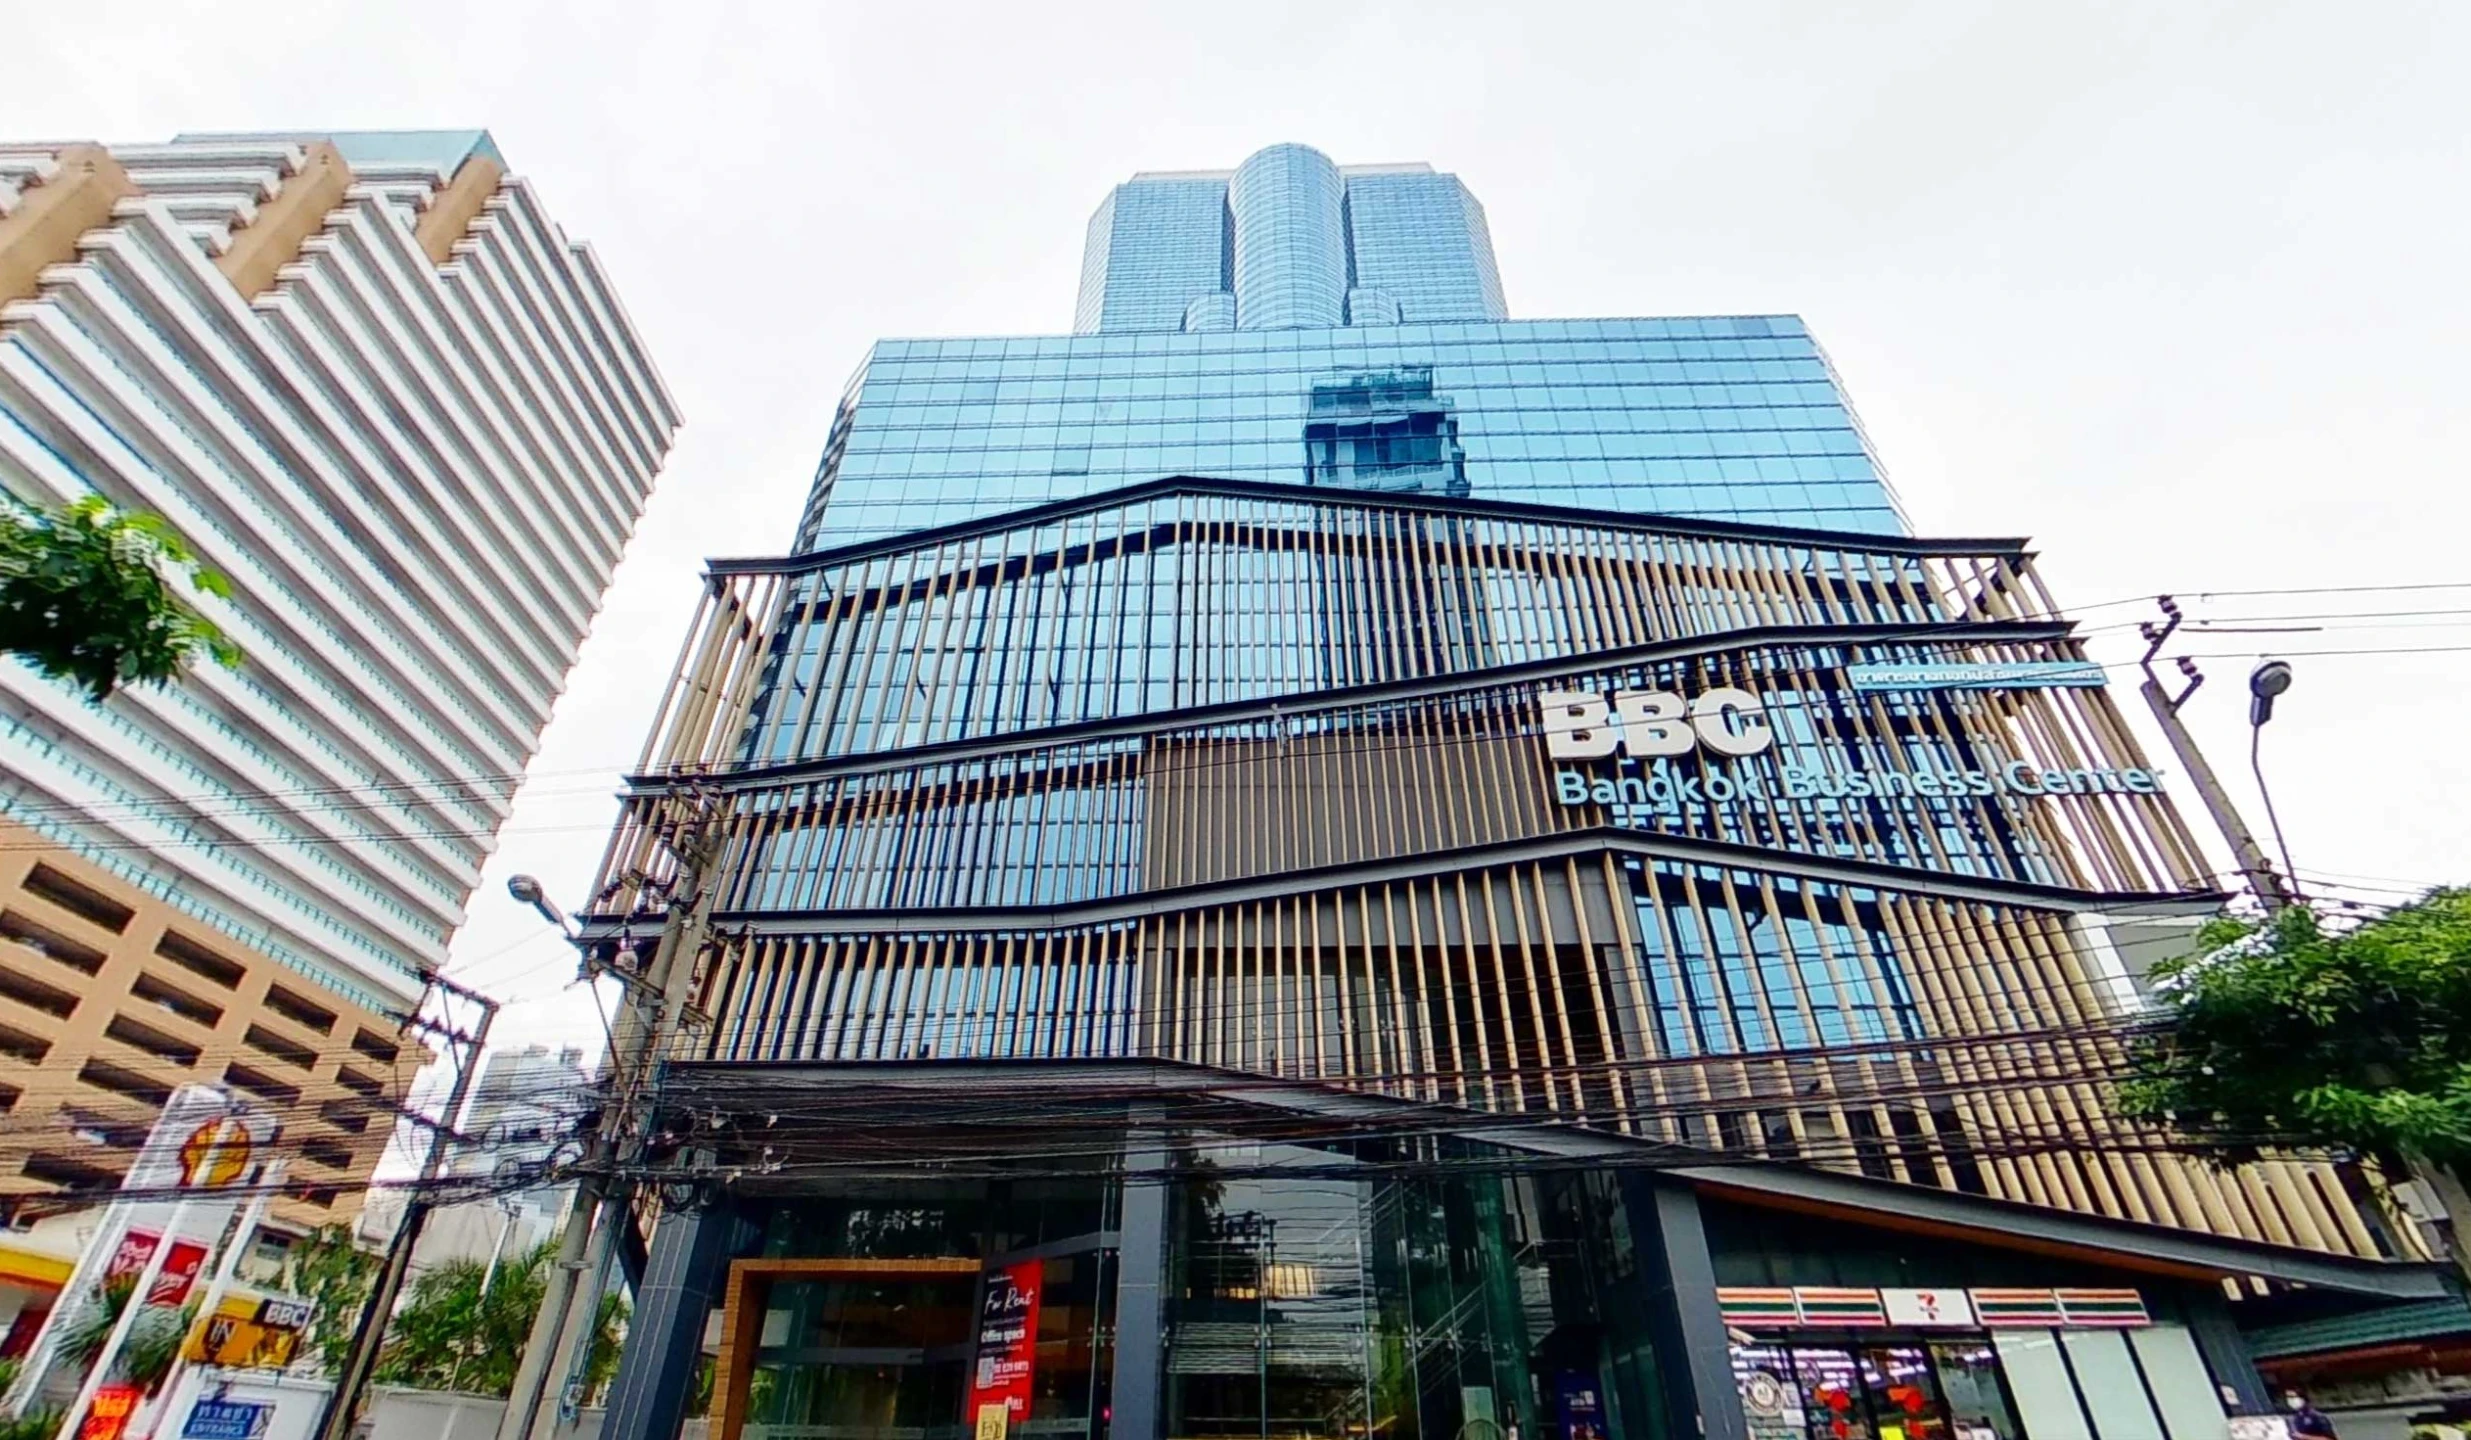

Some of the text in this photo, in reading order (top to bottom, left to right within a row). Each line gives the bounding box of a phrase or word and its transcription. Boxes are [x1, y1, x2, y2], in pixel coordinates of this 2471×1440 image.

[1541, 688, 1773, 760] BBC
[1555, 761, 2166, 814] Bangkok Business Center
[263, 1302, 308, 1326] BBC
[1003, 1286, 1034, 1312] Rent
